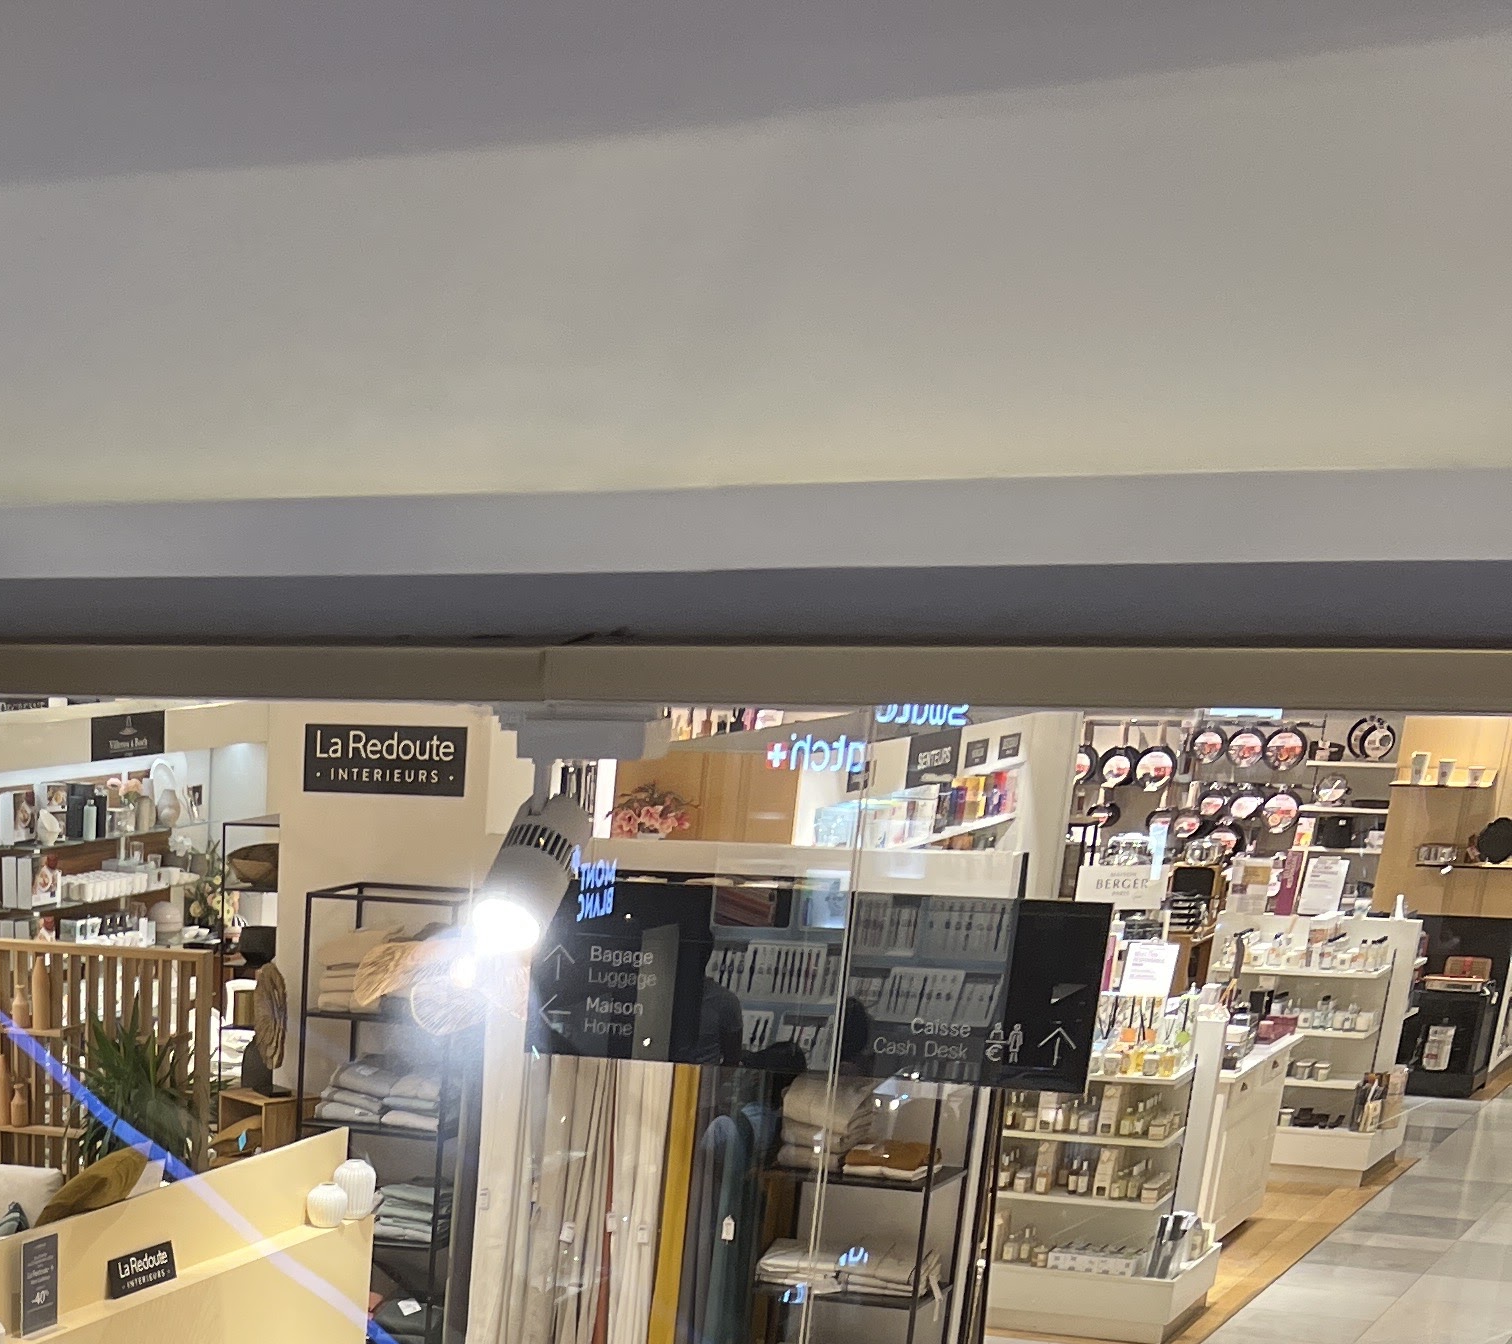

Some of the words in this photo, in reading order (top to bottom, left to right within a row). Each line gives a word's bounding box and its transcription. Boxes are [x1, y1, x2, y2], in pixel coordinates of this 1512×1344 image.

[316, 729, 342, 758] La
[348, 730, 455, 761] Redoute
[330, 768, 439, 783] INTERIEURS
[1096, 878, 1149, 890] BERGER
[590, 945, 654, 967] Bagage
[588, 968, 657, 990] Luggage
[585, 996, 644, 1015] Maison
[583, 1018, 634, 1036] Home
[910, 1017, 971, 1038] Caisse
[873, 1036, 917, 1056] Cash
[924, 1040, 968, 1060] Desk
[118, 1261, 131, 1279] La
[130, 1250, 168, 1276] Redoute
[126, 1269, 166, 1289] INTERIEURS
